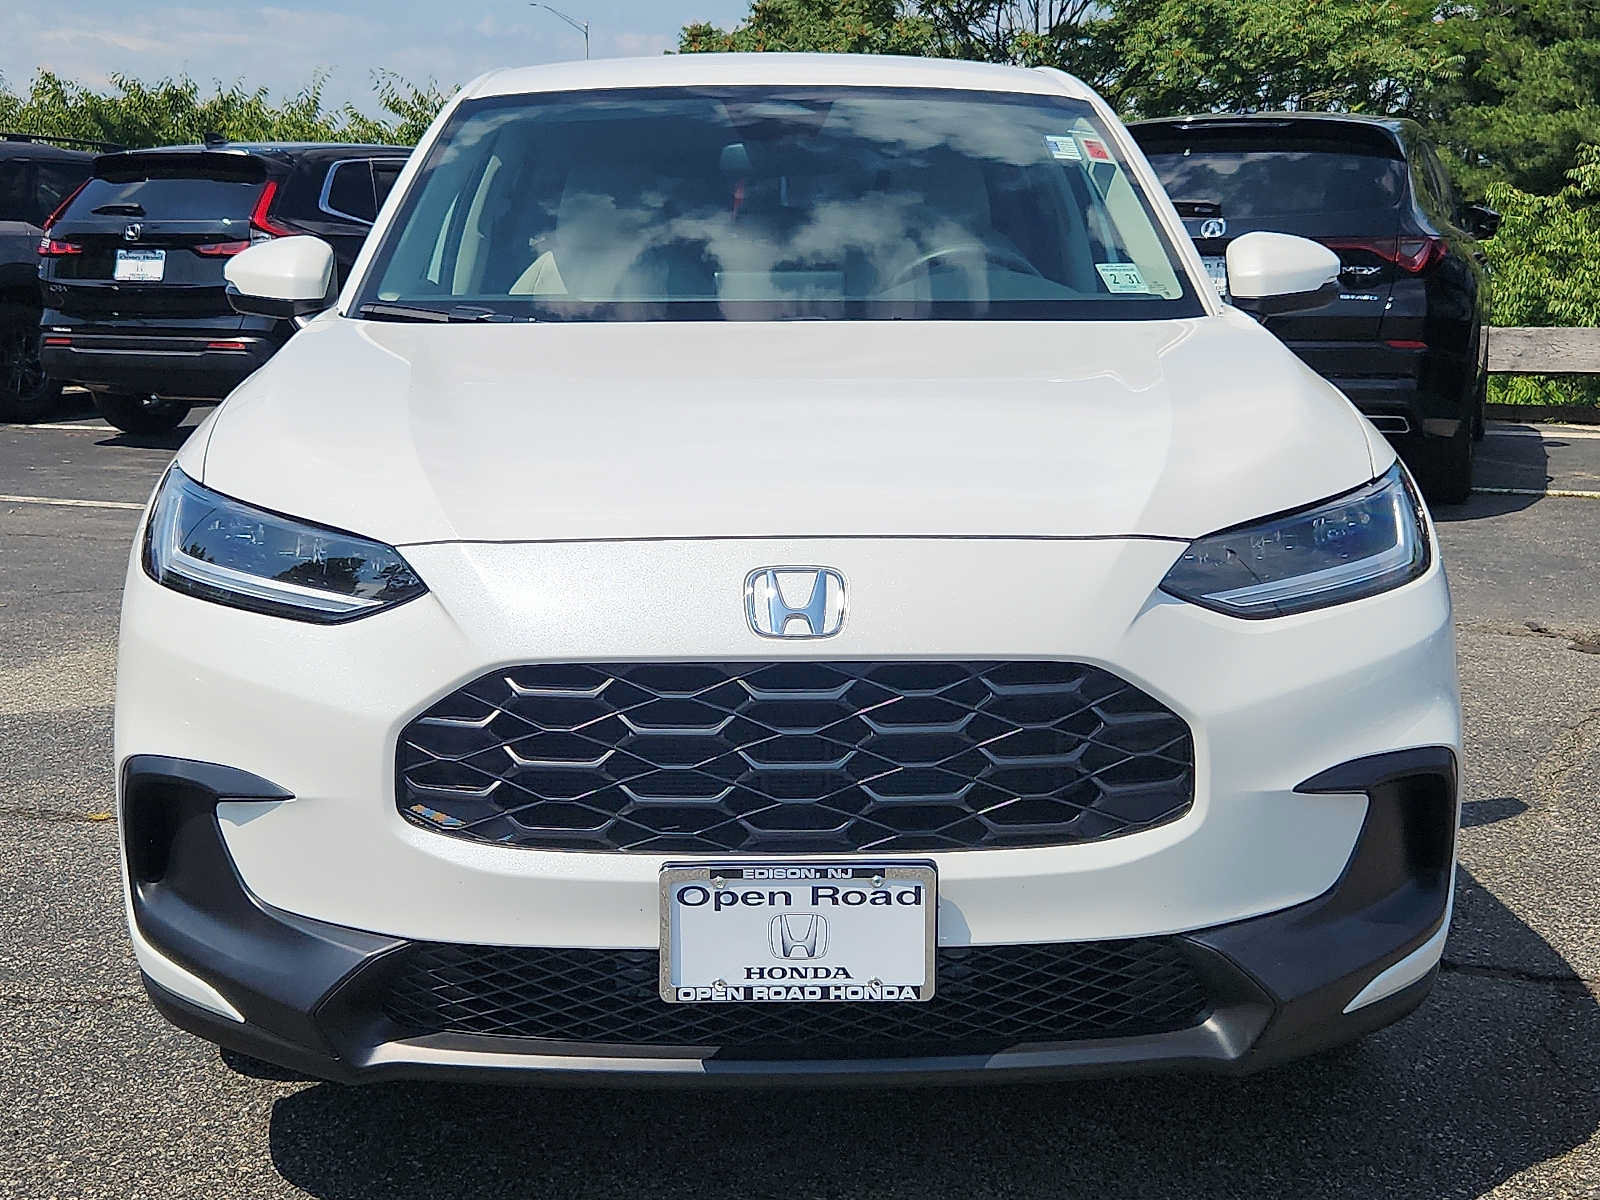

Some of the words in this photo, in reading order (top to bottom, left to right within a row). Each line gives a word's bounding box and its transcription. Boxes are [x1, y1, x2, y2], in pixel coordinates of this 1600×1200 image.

[1341, 266, 1381, 275] MDX
[1109, 273, 1120, 285] 2
[1125, 273, 1142, 285] 31
[742, 868, 821, 880] EDISON,
[827, 867, 853, 879] NJ
[676, 885, 792, 911] Open
[811, 885, 921, 906] Road
[743, 966, 853, 980] HONDA
[677, 986, 745, 1001] OPEN
[752, 986, 822, 1001] ROAD
[829, 985, 918, 1001] HONDA
